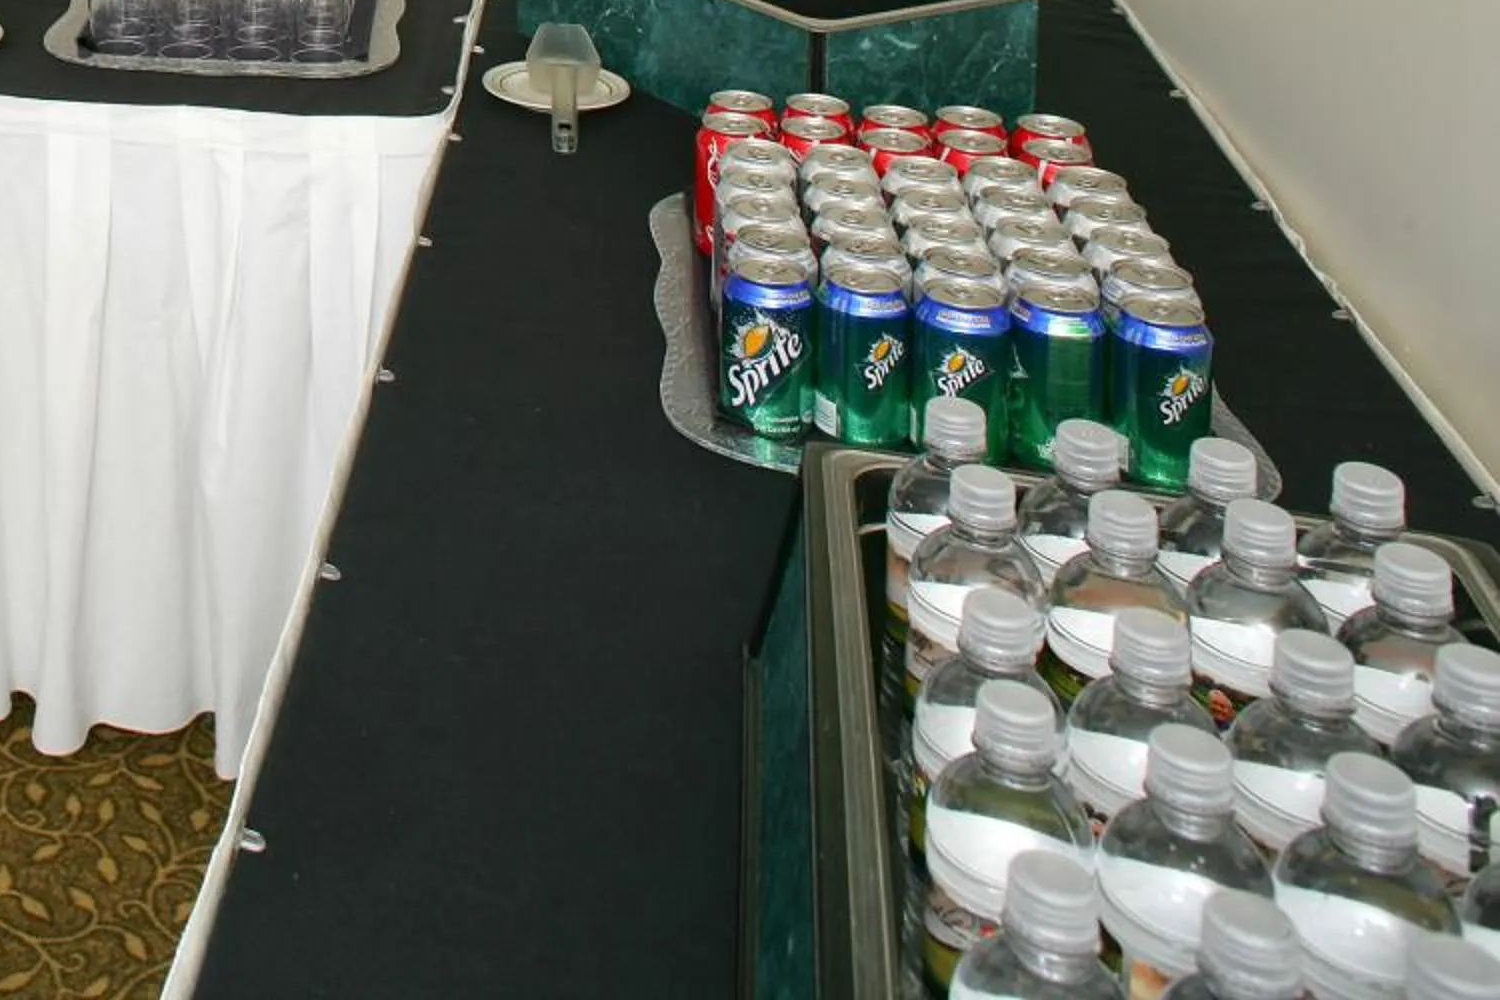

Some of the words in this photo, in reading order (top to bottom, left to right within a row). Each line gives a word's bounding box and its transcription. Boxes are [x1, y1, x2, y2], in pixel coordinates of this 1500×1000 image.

[727, 326, 804, 408] Sprite
[863, 339, 905, 390] Sprite
[937, 354, 986, 398] Sprite
[1159, 373, 1209, 426] Sprite
